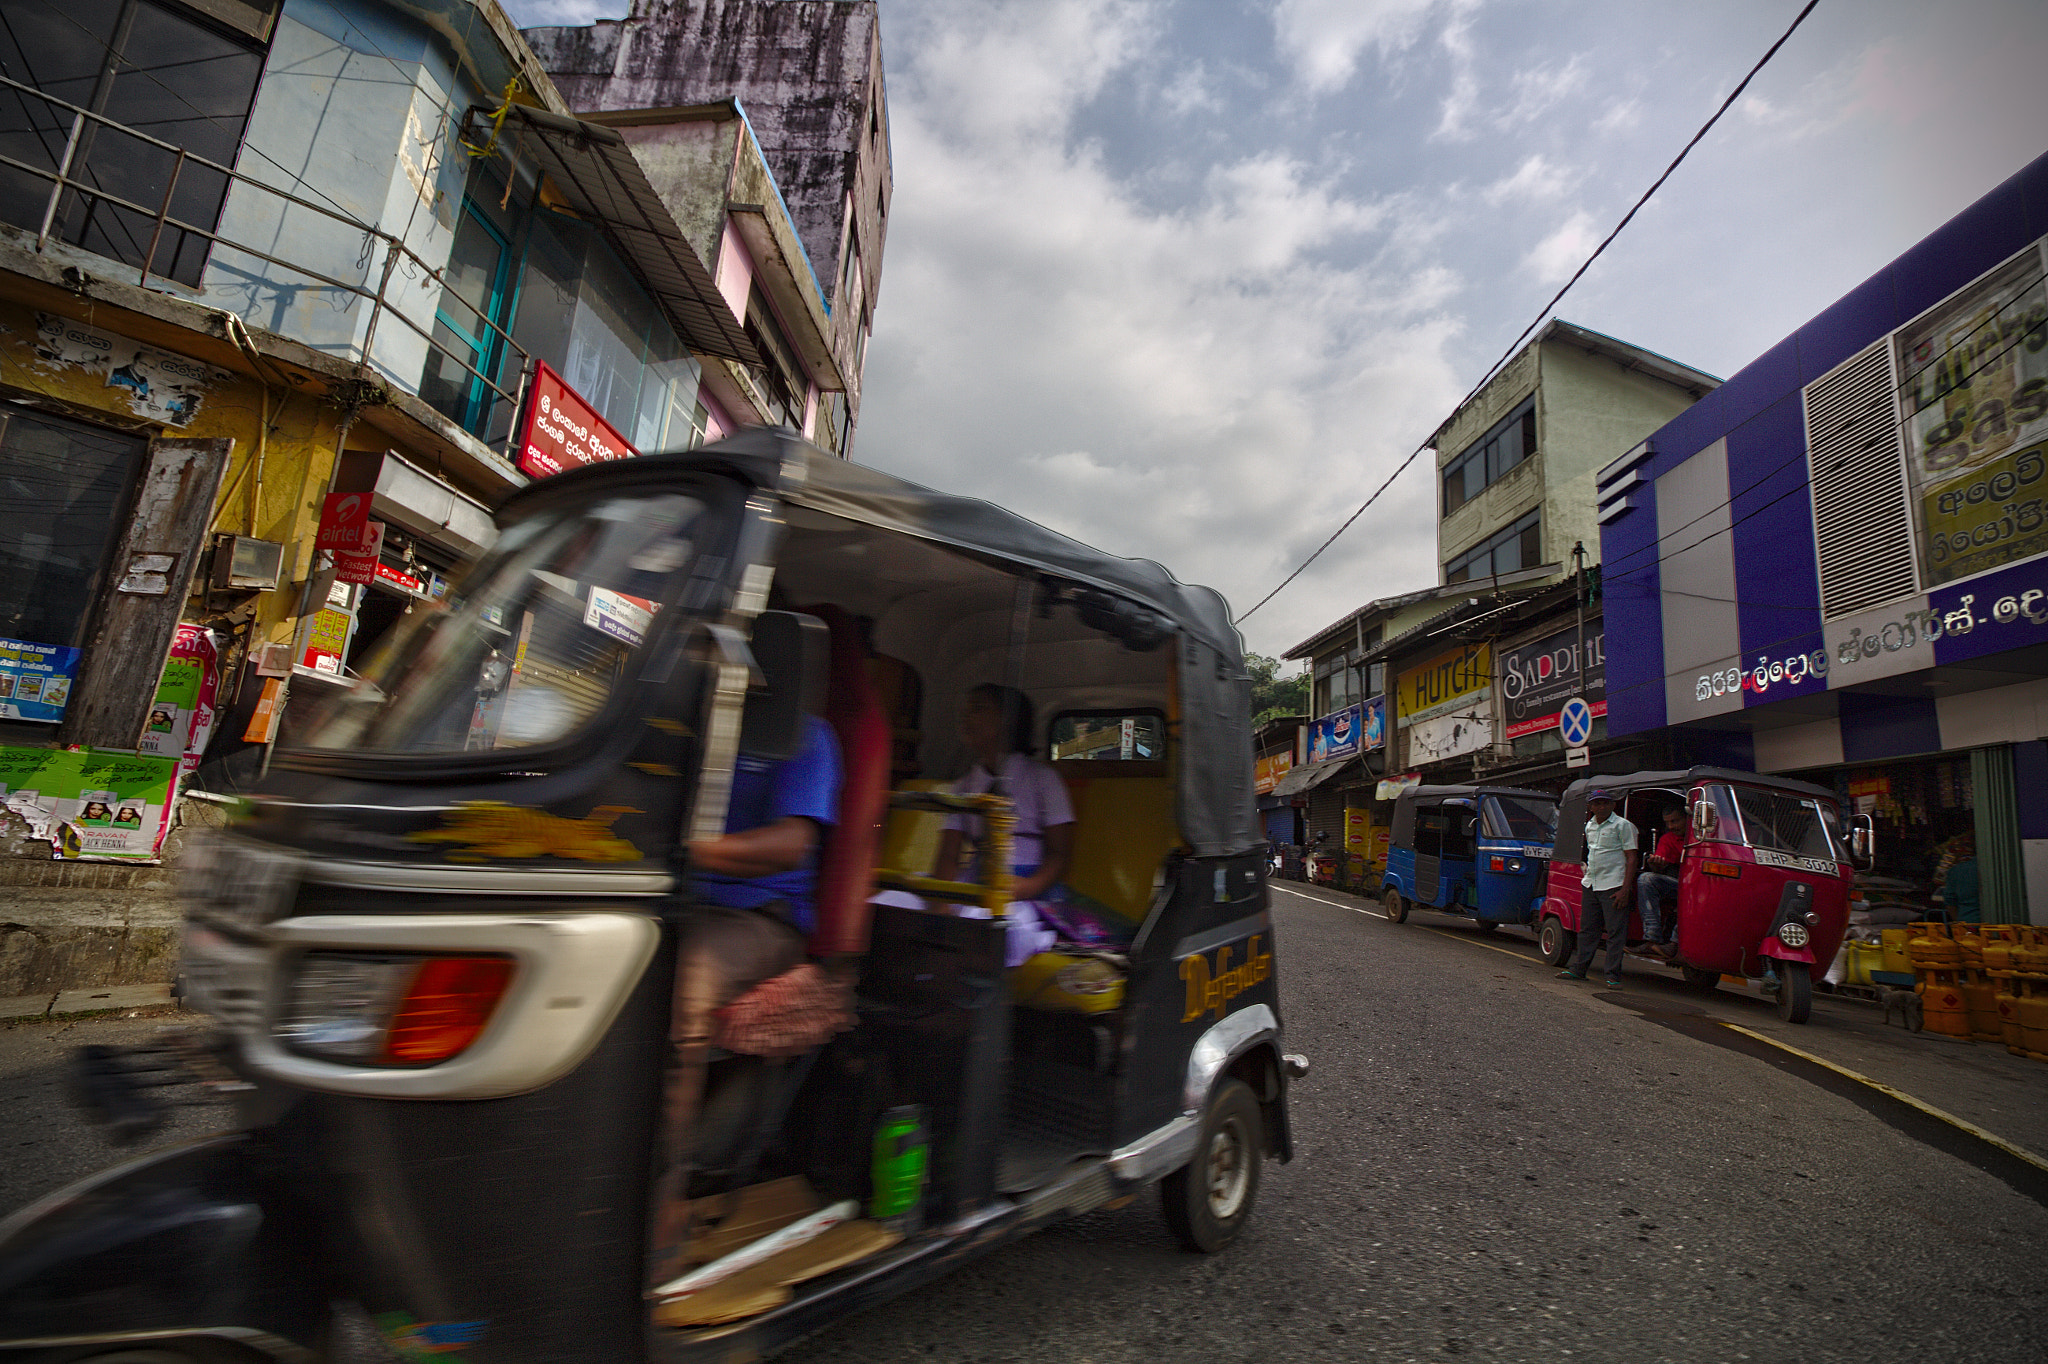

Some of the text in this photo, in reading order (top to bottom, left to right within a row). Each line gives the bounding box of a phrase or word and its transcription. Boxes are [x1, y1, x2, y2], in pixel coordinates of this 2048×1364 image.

[552, 408, 588, 442] ලංකාවේ
[1924, 376, 2048, 474] gas
[537, 416, 597, 466] ජංගම දුරකථ
[321, 525, 359, 543] airtel
[337, 568, 373, 583] Network
[342, 558, 373, 573] Fastest
[1416, 645, 1478, 709] HUTCH
[1503, 633, 1606, 699] SAPPHIR
[101, 838, 126, 849] HENNA
[1803, 858, 1838, 876] 3012
